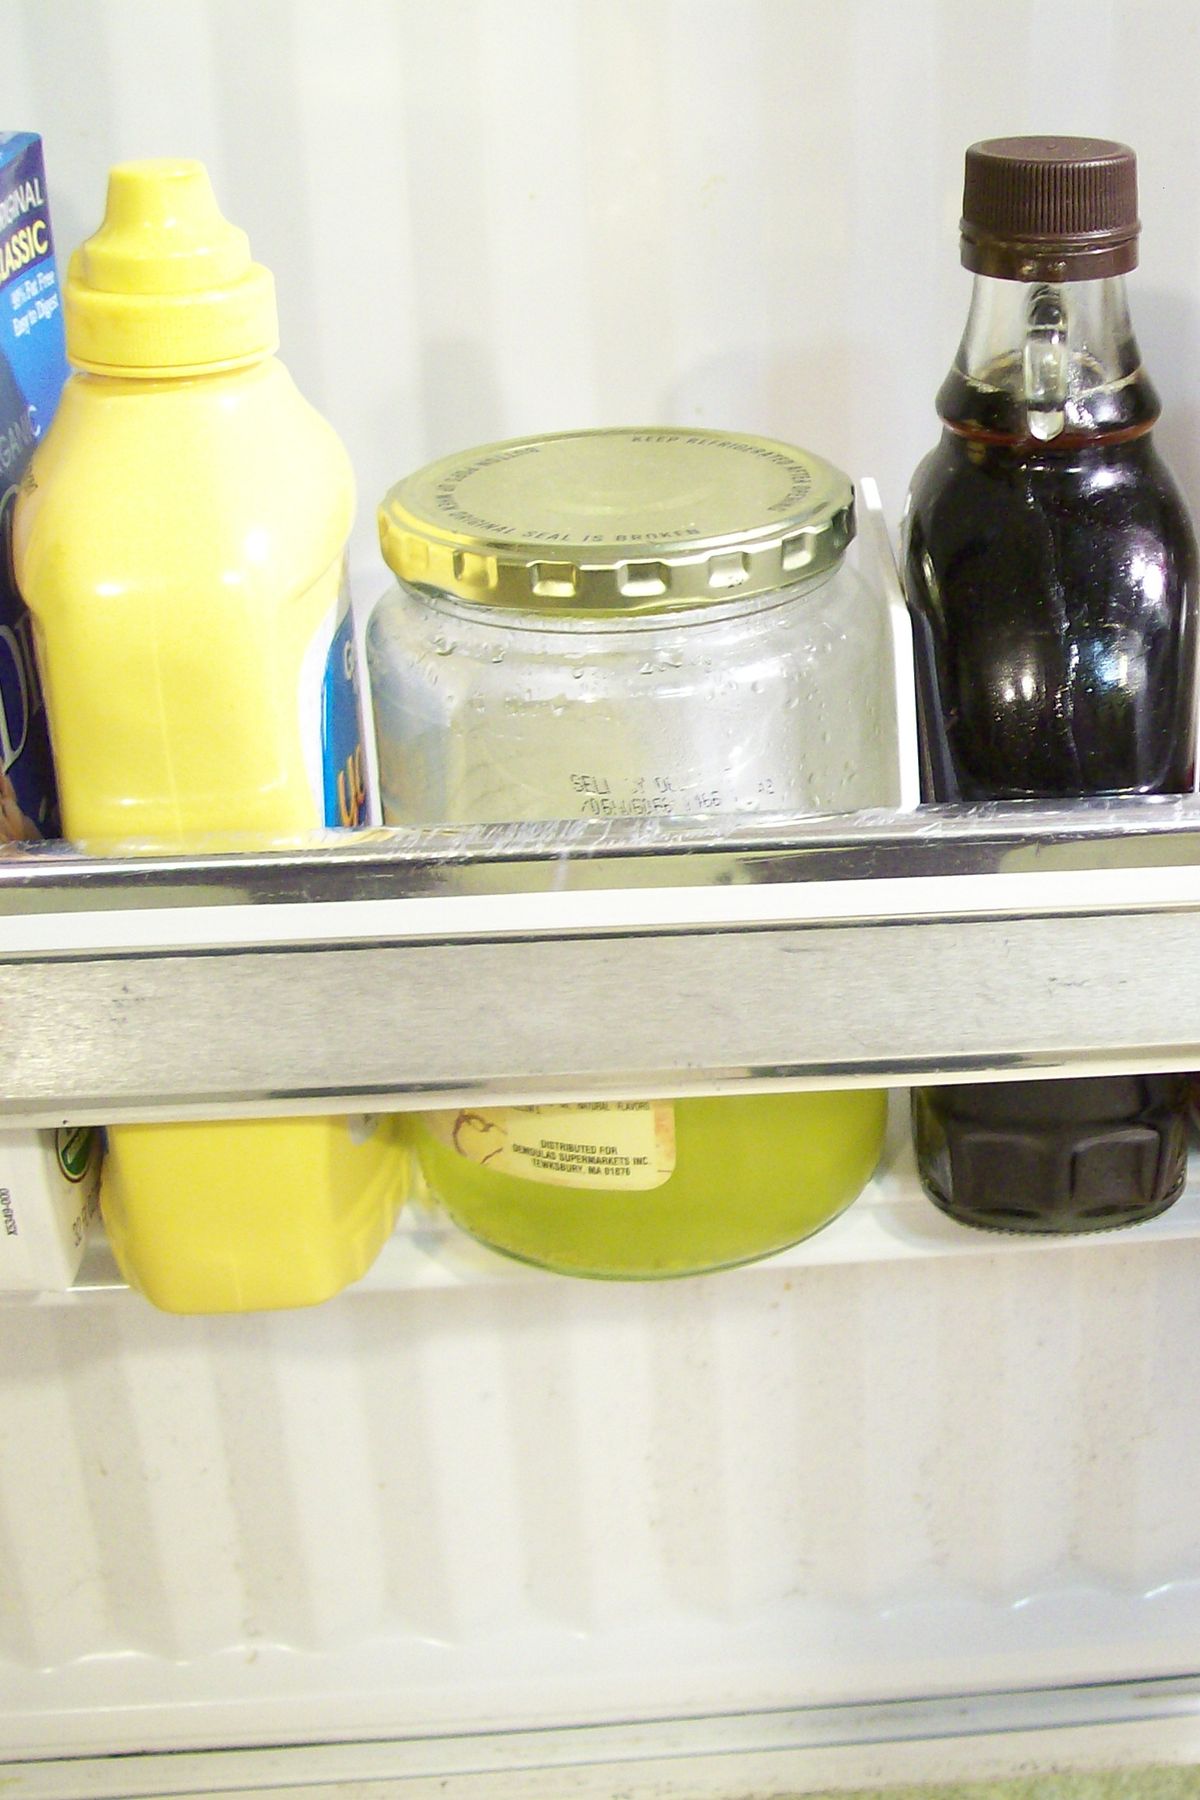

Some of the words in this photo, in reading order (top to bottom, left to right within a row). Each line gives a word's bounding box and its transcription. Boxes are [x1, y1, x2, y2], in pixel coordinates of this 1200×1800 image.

[686, 437, 795, 465] REFRIGERATED
[449, 510, 517, 535] ORIGINAL
[522, 530, 572, 543] SEAL
[582, 533, 604, 542] IS
[615, 528, 701, 542] BROKEN
[540, 1139, 597, 1155] DISTRIBUTED
[599, 1145, 618, 1155] FOR
[559, 1151, 631, 1166] SUPERMARKETS
[588, 1166, 602, 1175] MA
[604, 1167, 631, 1176] 01876
